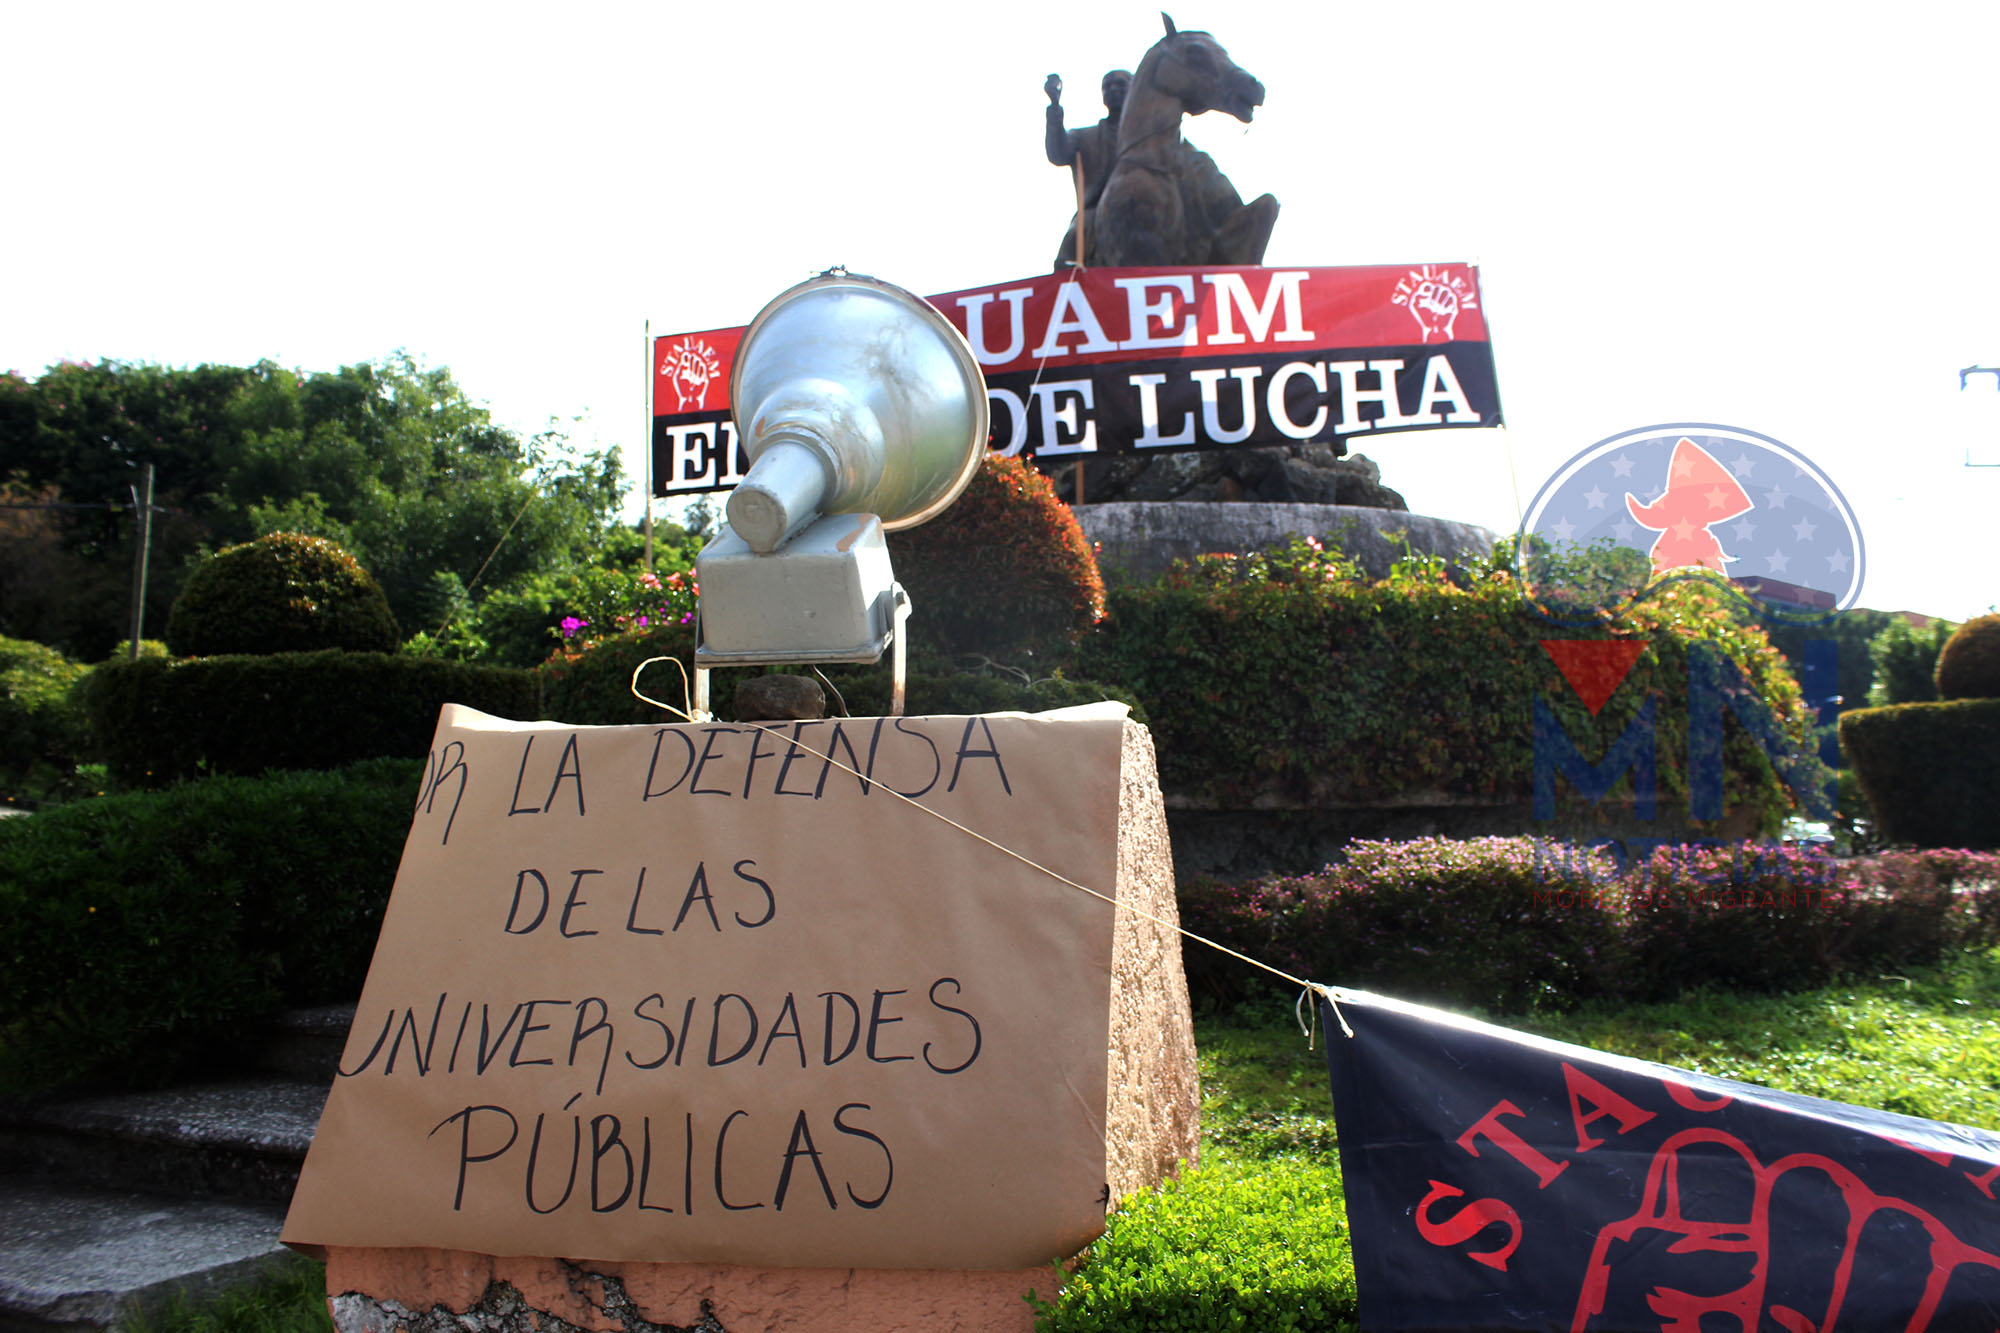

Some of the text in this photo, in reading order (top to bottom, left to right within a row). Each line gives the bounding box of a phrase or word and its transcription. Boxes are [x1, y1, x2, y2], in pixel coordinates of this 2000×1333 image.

[956, 271, 1315, 366] UAEM
[1129, 354, 1481, 449] LUCHA
[508, 733, 585, 816] LA
[643, 717, 1012, 801] DEFENSA
[504, 859, 777, 938] DE LAS
[336, 976, 983, 1095] UNIVERSIDADES
[428, 1092, 894, 1215] PÚBLICAS
